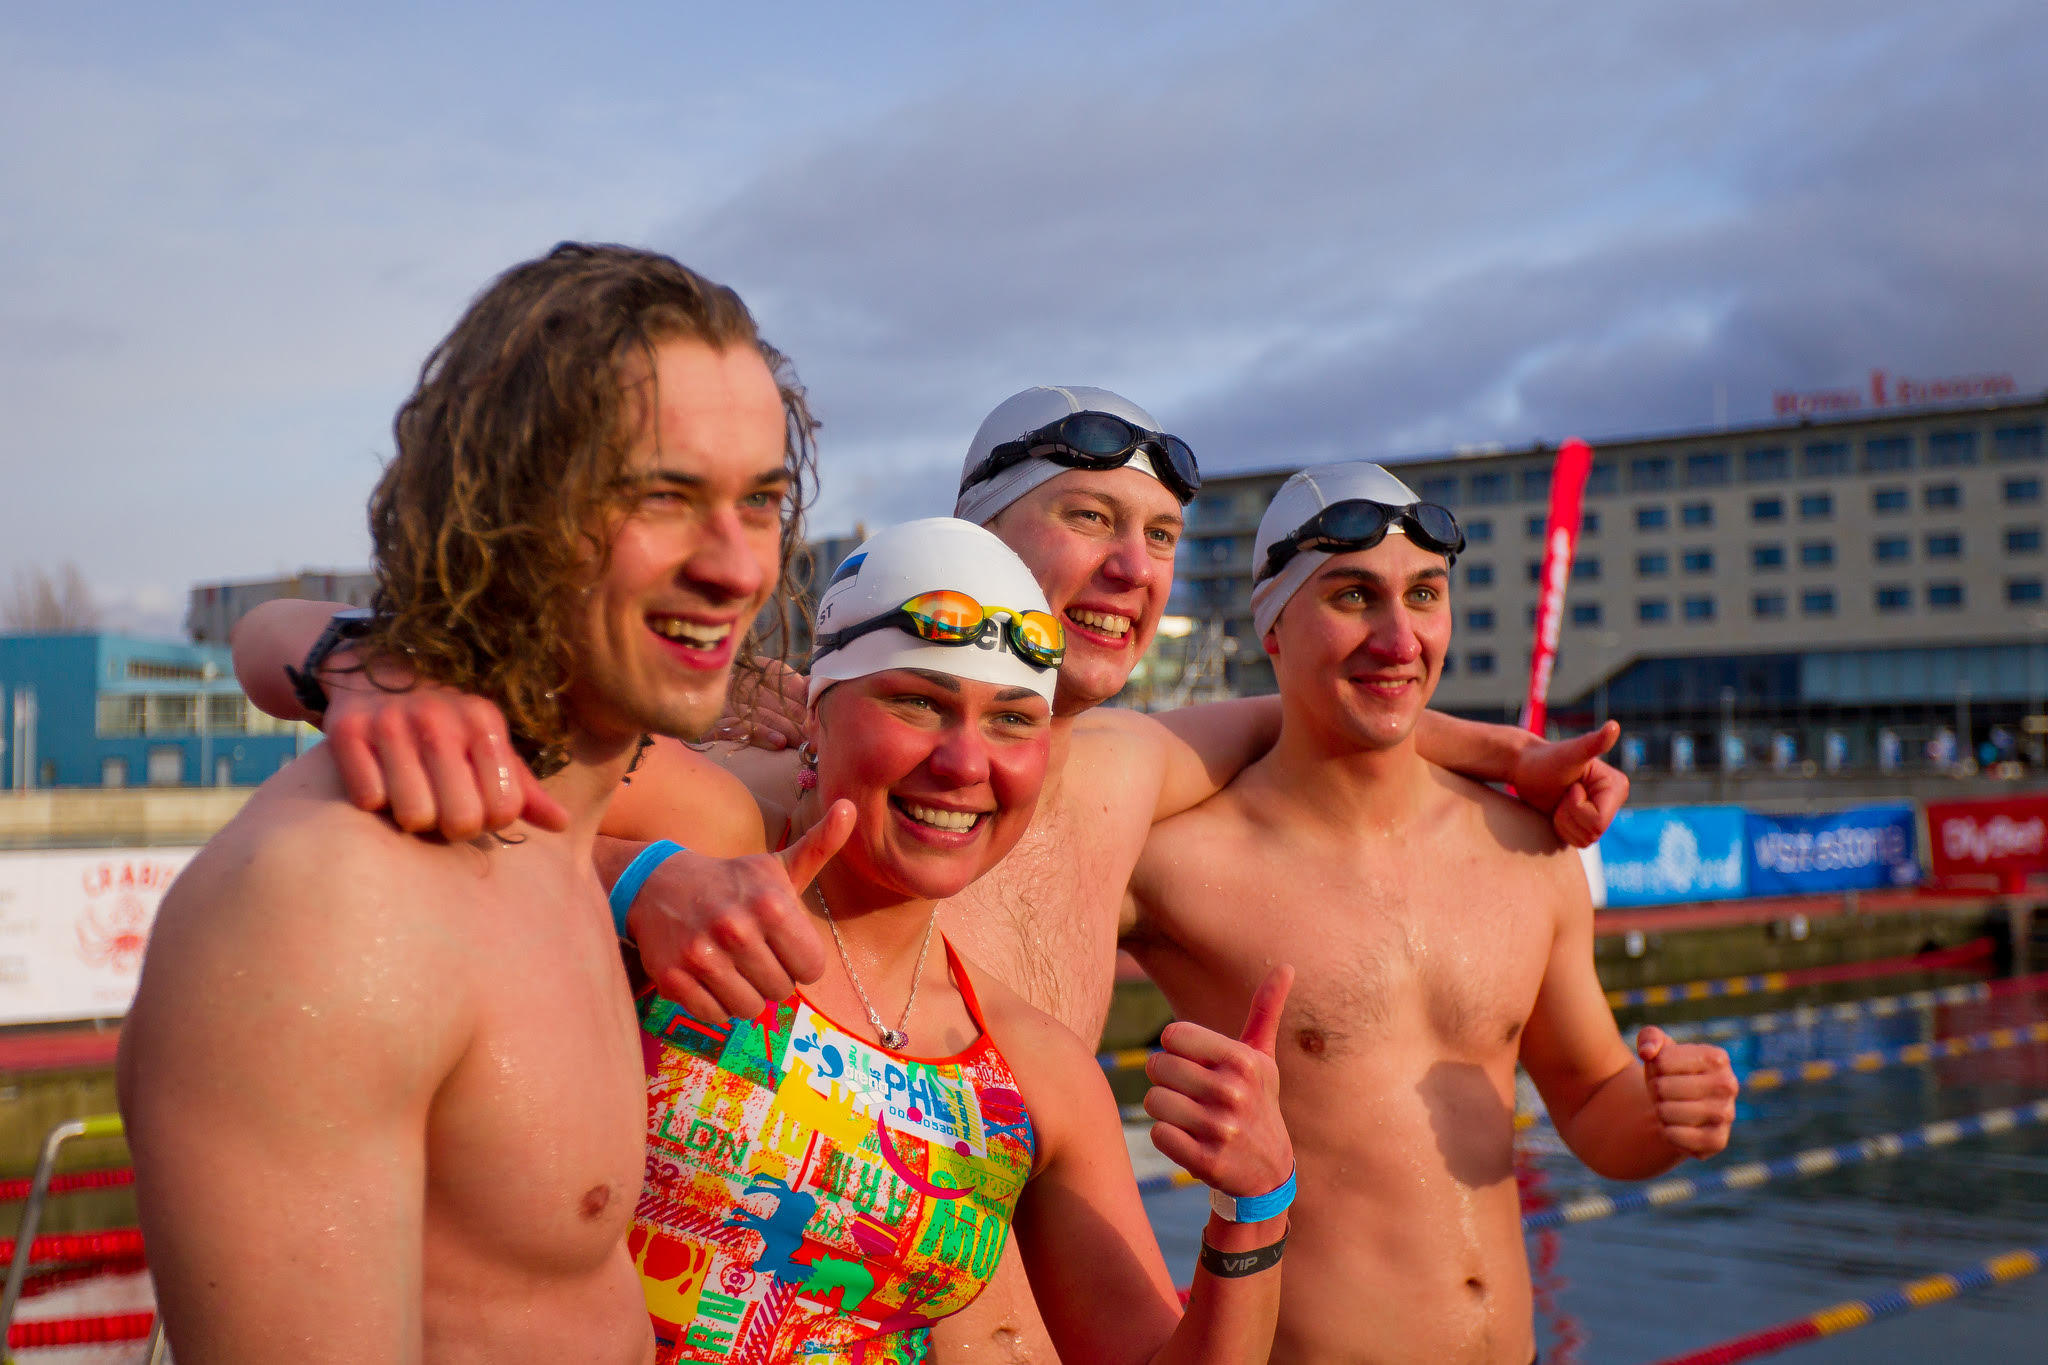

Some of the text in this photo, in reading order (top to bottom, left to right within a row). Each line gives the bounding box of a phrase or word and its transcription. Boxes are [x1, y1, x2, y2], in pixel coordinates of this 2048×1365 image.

[658, 1109, 750, 1167] LDN
[1222, 1256, 1258, 1272] VIP
[677, 1289, 747, 1365] RN
